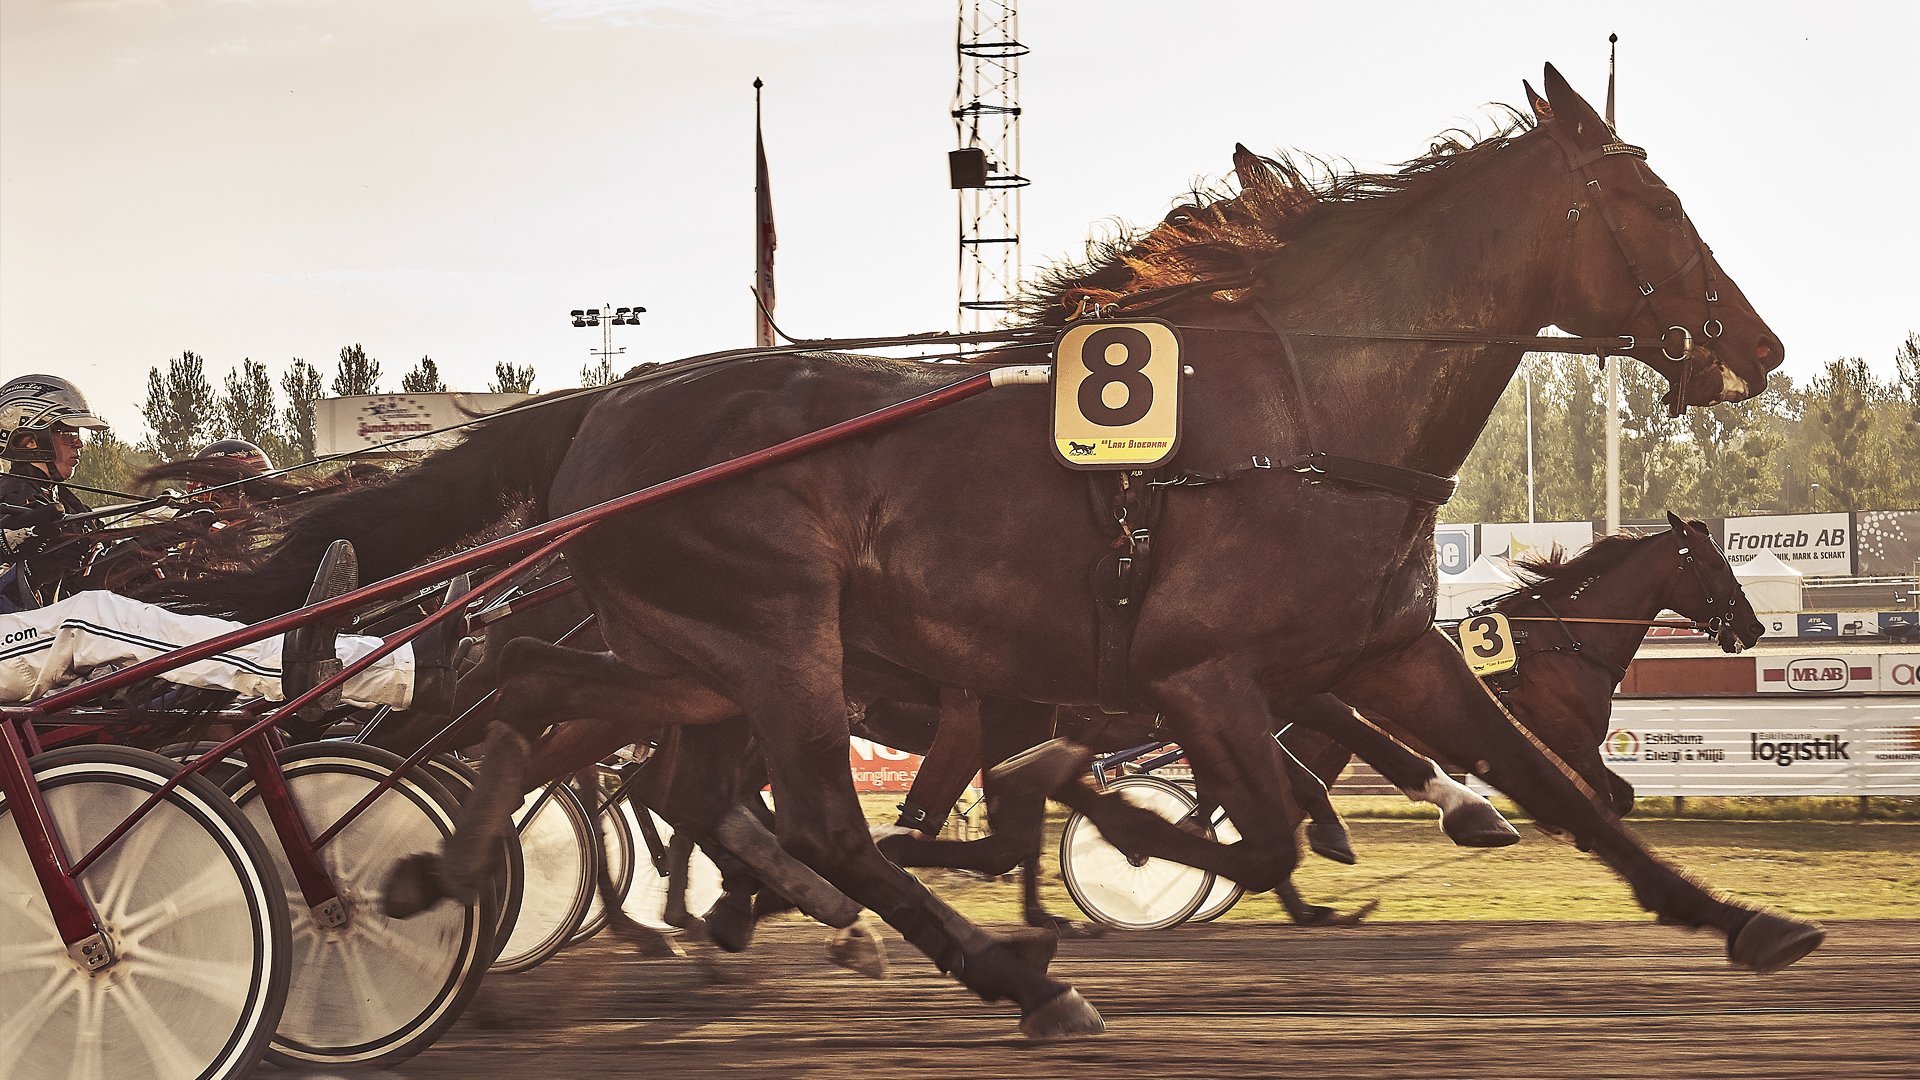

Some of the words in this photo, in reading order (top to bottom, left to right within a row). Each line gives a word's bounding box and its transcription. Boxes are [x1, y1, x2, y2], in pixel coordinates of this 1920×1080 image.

[1078, 326, 1154, 427] 8
[1727, 530, 1809, 550] Frontab
[1815, 528, 1845, 547] AB
[1792, 551, 1812, 560] MARK
[1813, 551, 1819, 560] &
[1820, 551, 1846, 560] SCHAKT
[1, 627, 38, 646] .com
[1469, 616, 1504, 658] 3
[1751, 732, 1850, 766] logistik
